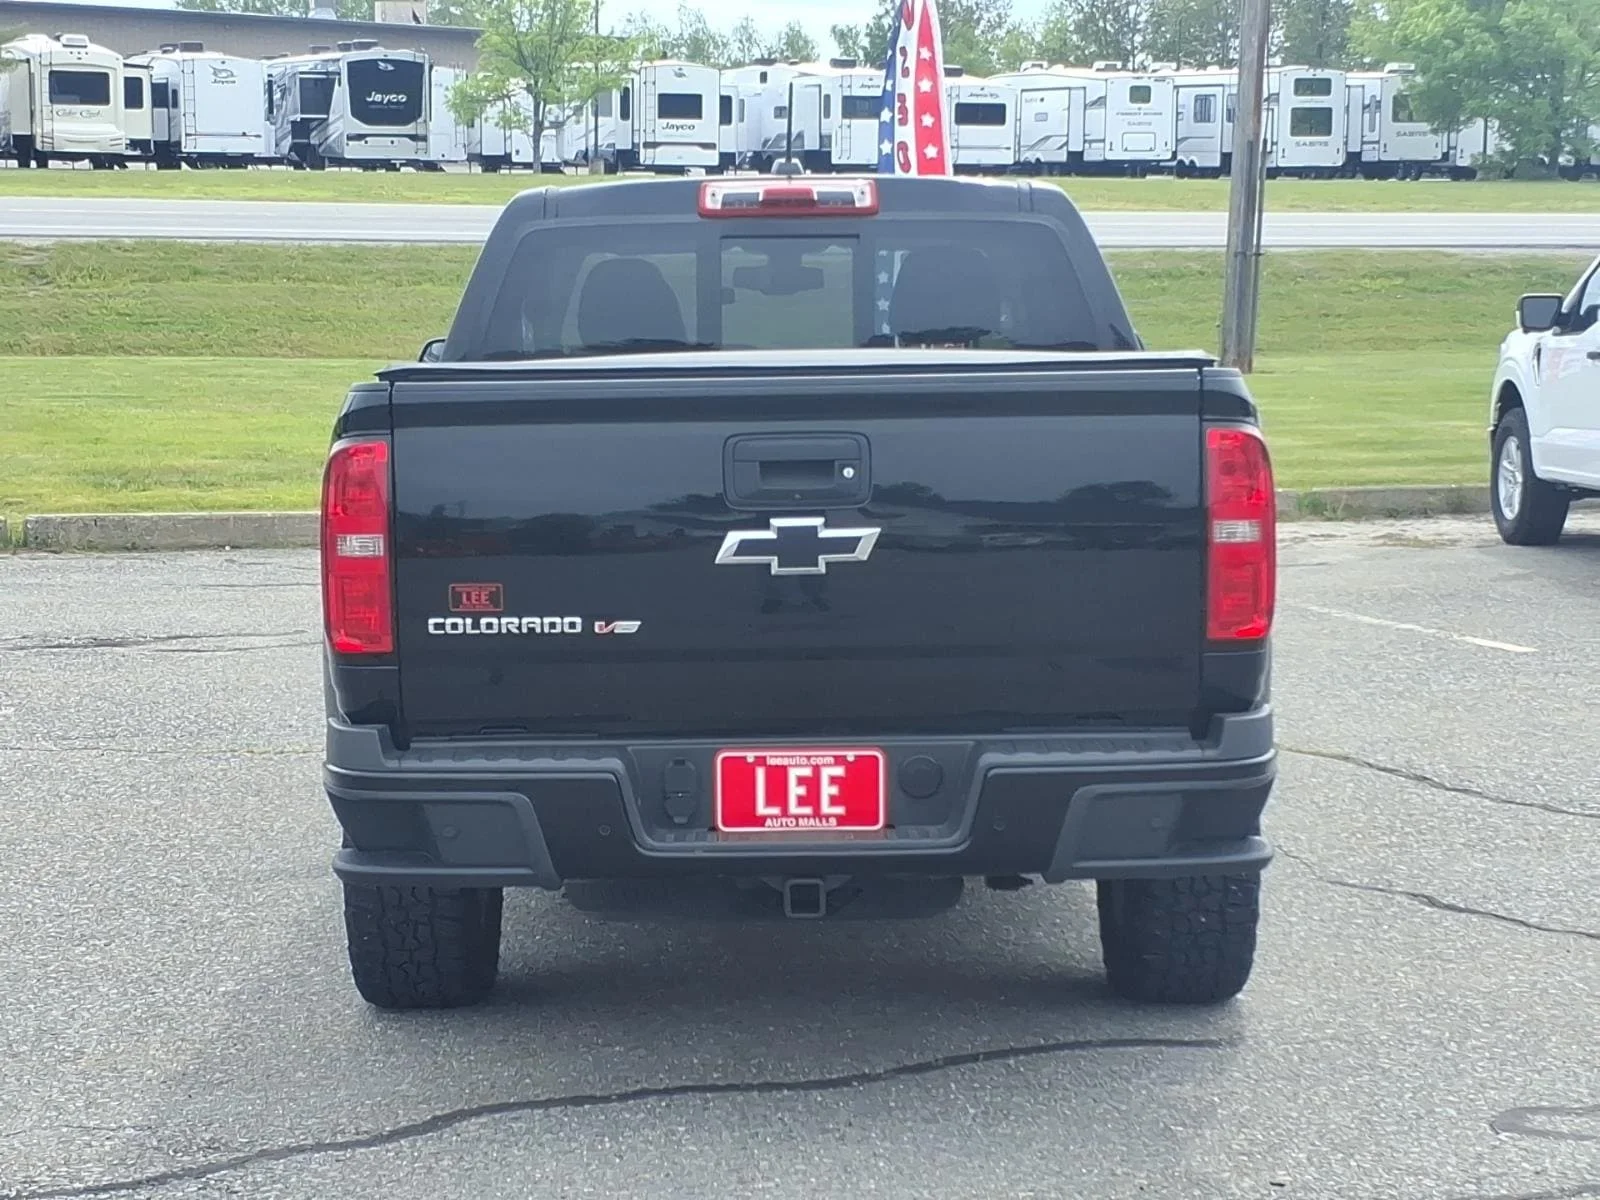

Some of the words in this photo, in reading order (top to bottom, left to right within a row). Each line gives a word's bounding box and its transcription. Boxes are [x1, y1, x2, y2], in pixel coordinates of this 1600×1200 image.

[365, 91, 407, 104] Jayco
[661, 121, 696, 132] Jayco
[462, 591, 490, 604] LEE
[428, 617, 582, 634] COLORADO
[766, 755, 835, 766] leeauto.com
[755, 766, 846, 816] LEE
[764, 817, 797, 827] AUTO
[798, 817, 837, 827] MALLS
